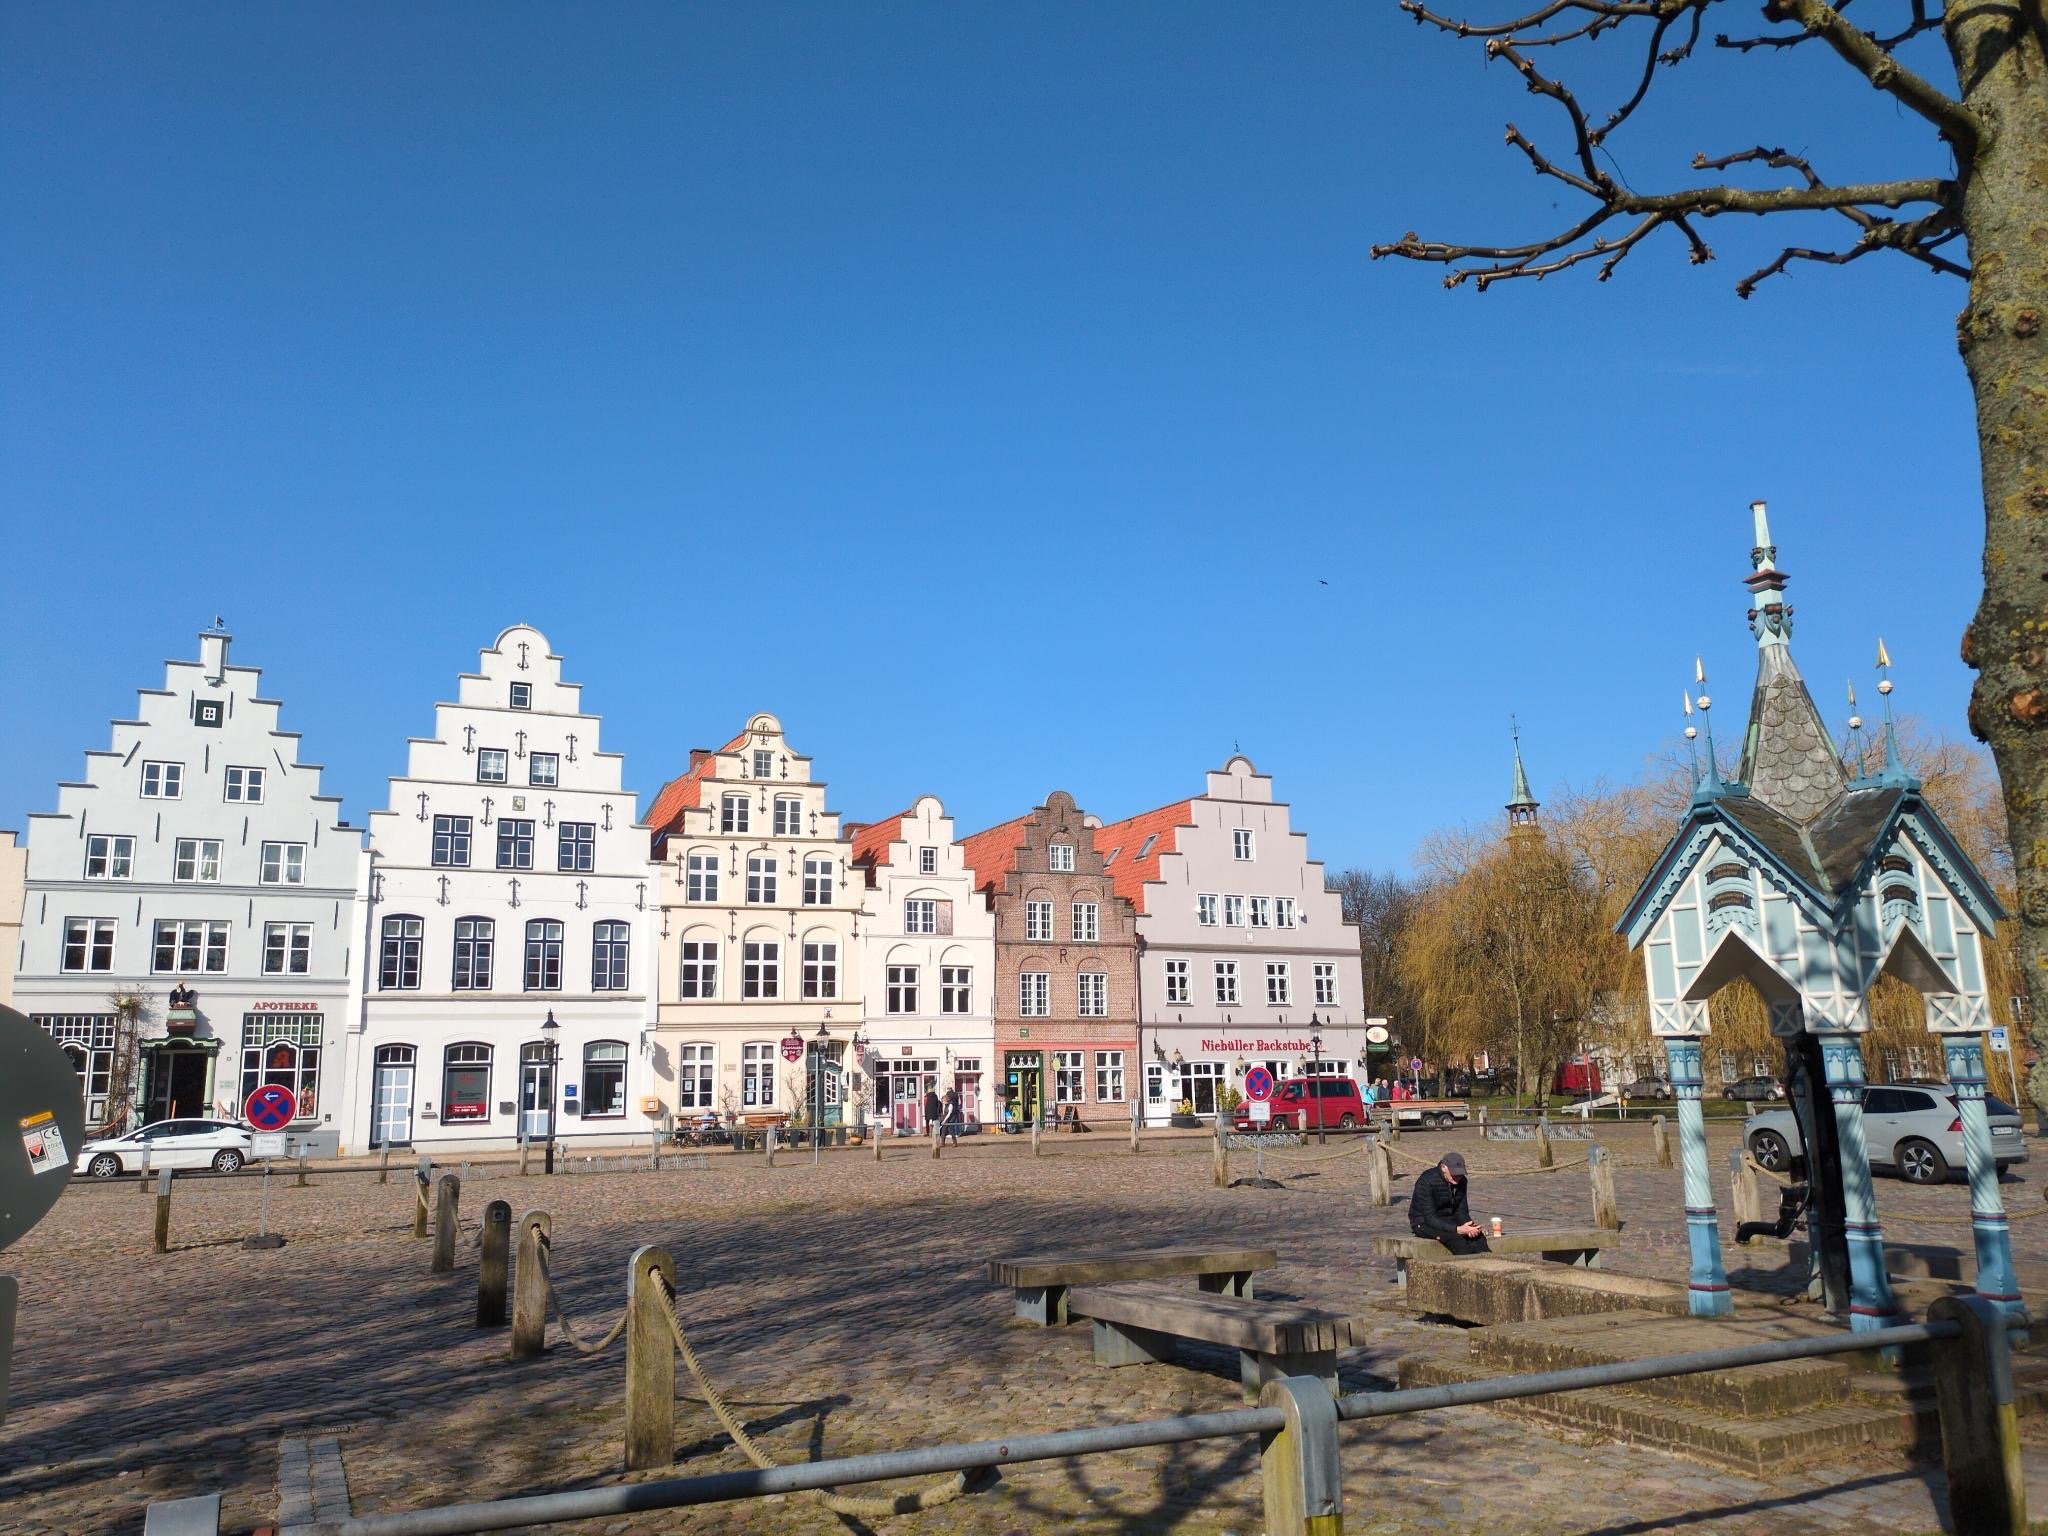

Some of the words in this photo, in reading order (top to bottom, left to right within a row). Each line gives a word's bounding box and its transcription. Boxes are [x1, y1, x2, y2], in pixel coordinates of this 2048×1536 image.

[1060, 949, 1068, 963] R
[252, 1002, 318, 1010] APOTHEKE
[1201, 1039, 1255, 1051] Niebüller
[1256, 1039, 1311, 1051] Backstube
[44, 1127, 59, 1139] CE
